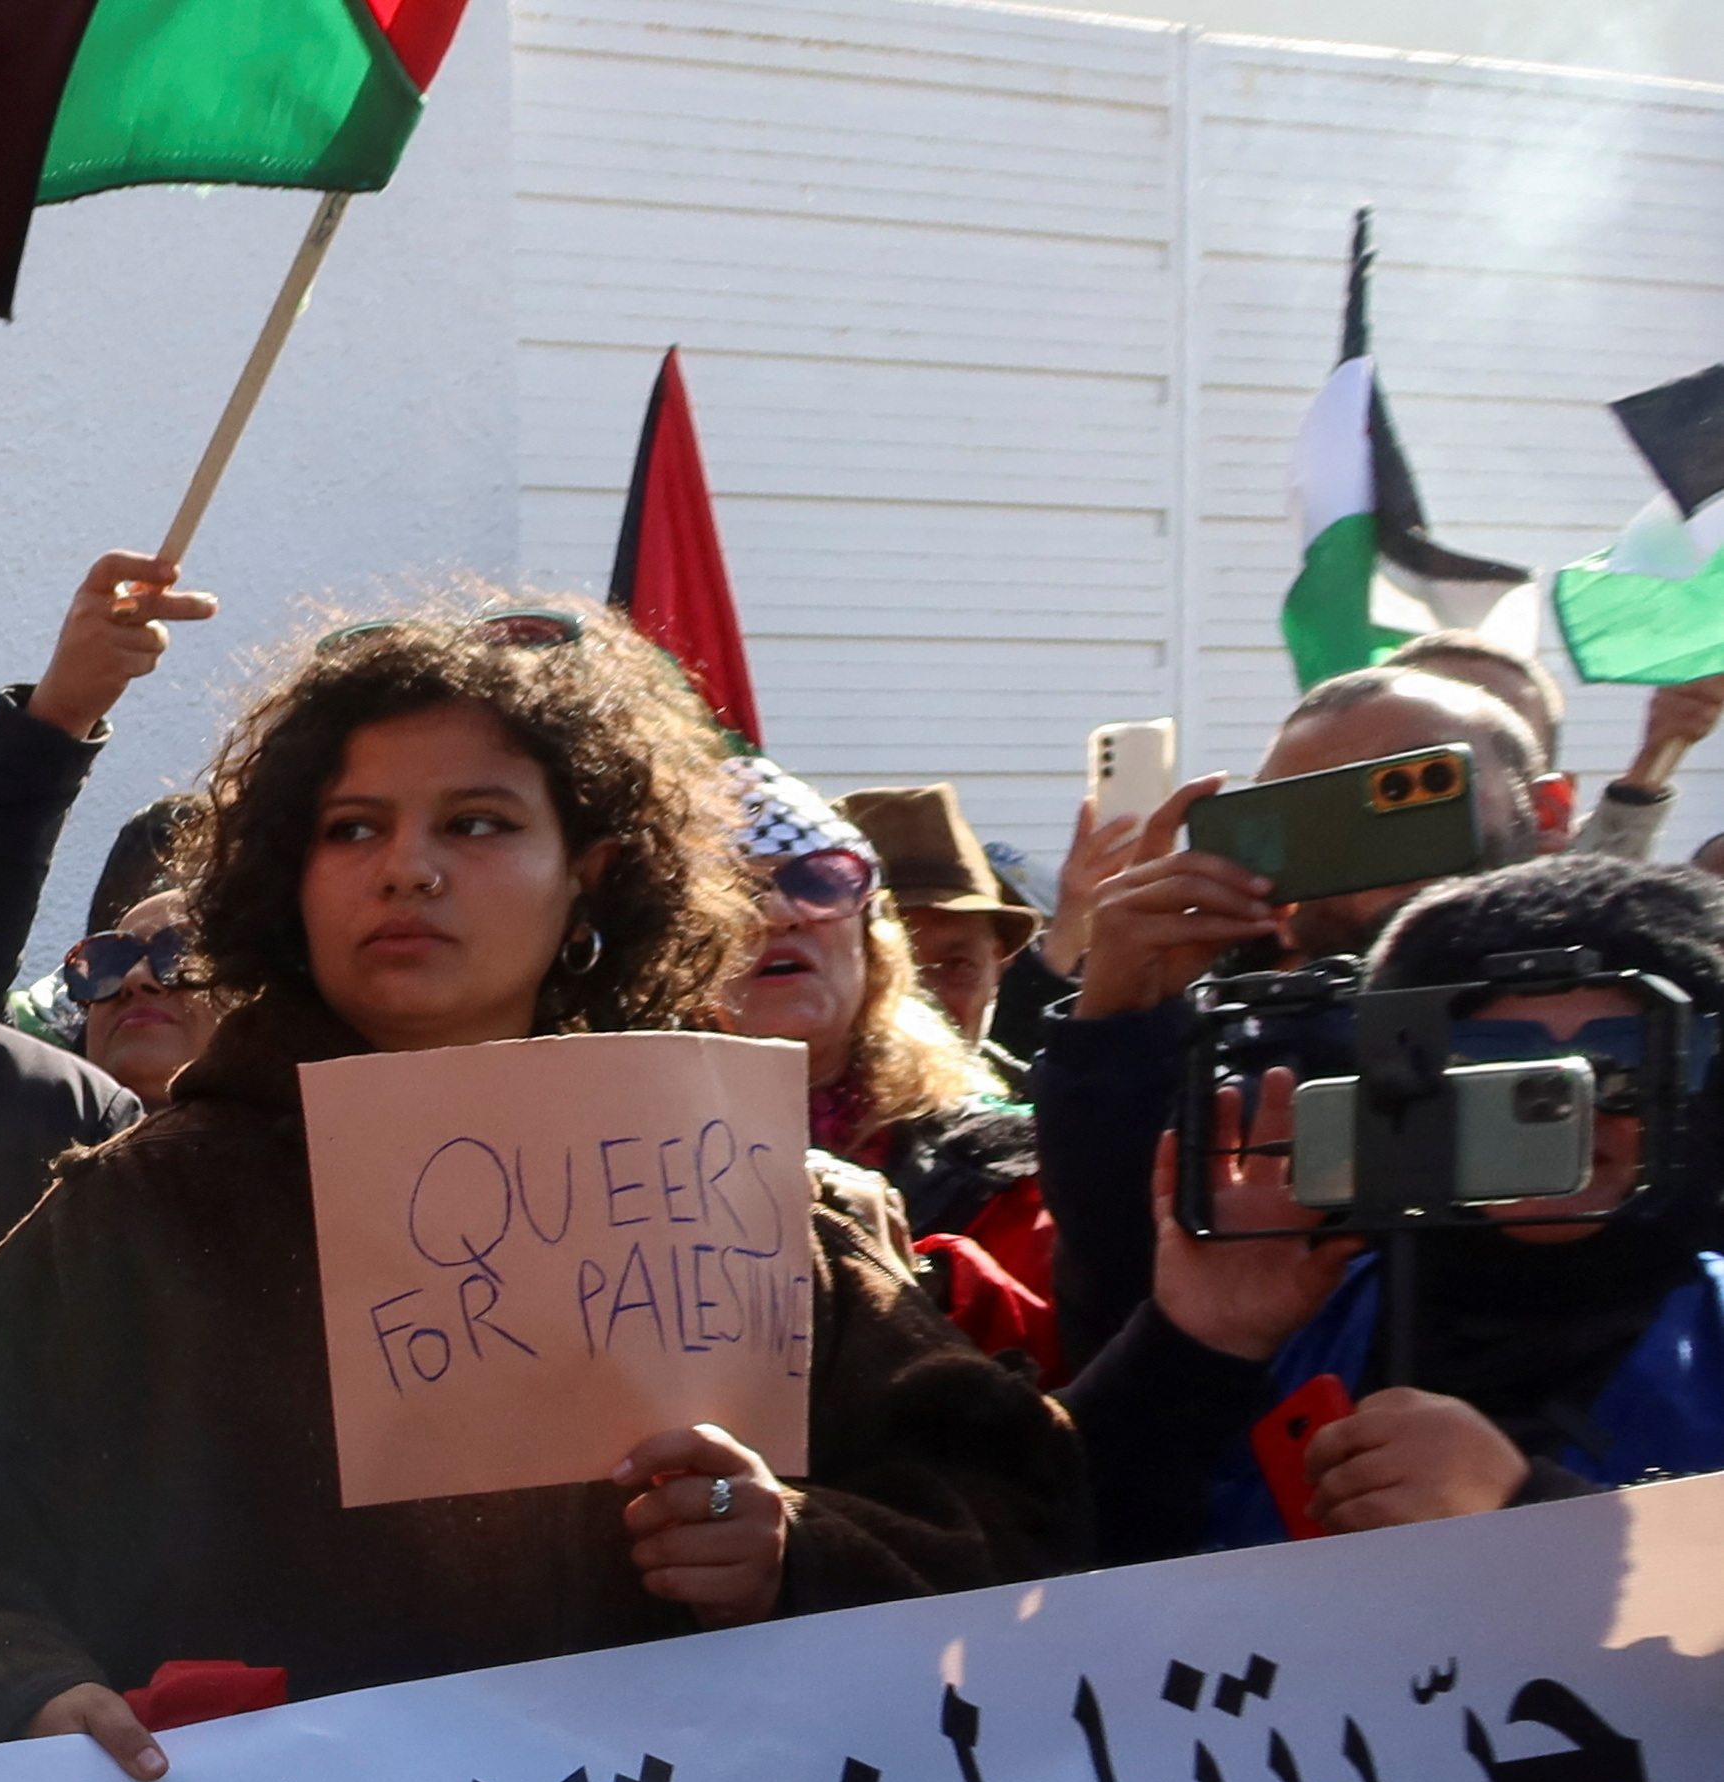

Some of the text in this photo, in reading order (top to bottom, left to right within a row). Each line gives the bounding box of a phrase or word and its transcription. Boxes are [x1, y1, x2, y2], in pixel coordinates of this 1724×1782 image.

[409, 1119, 782, 1284] QUEERS
[370, 1241, 810, 1398] FOR PALESTINE
